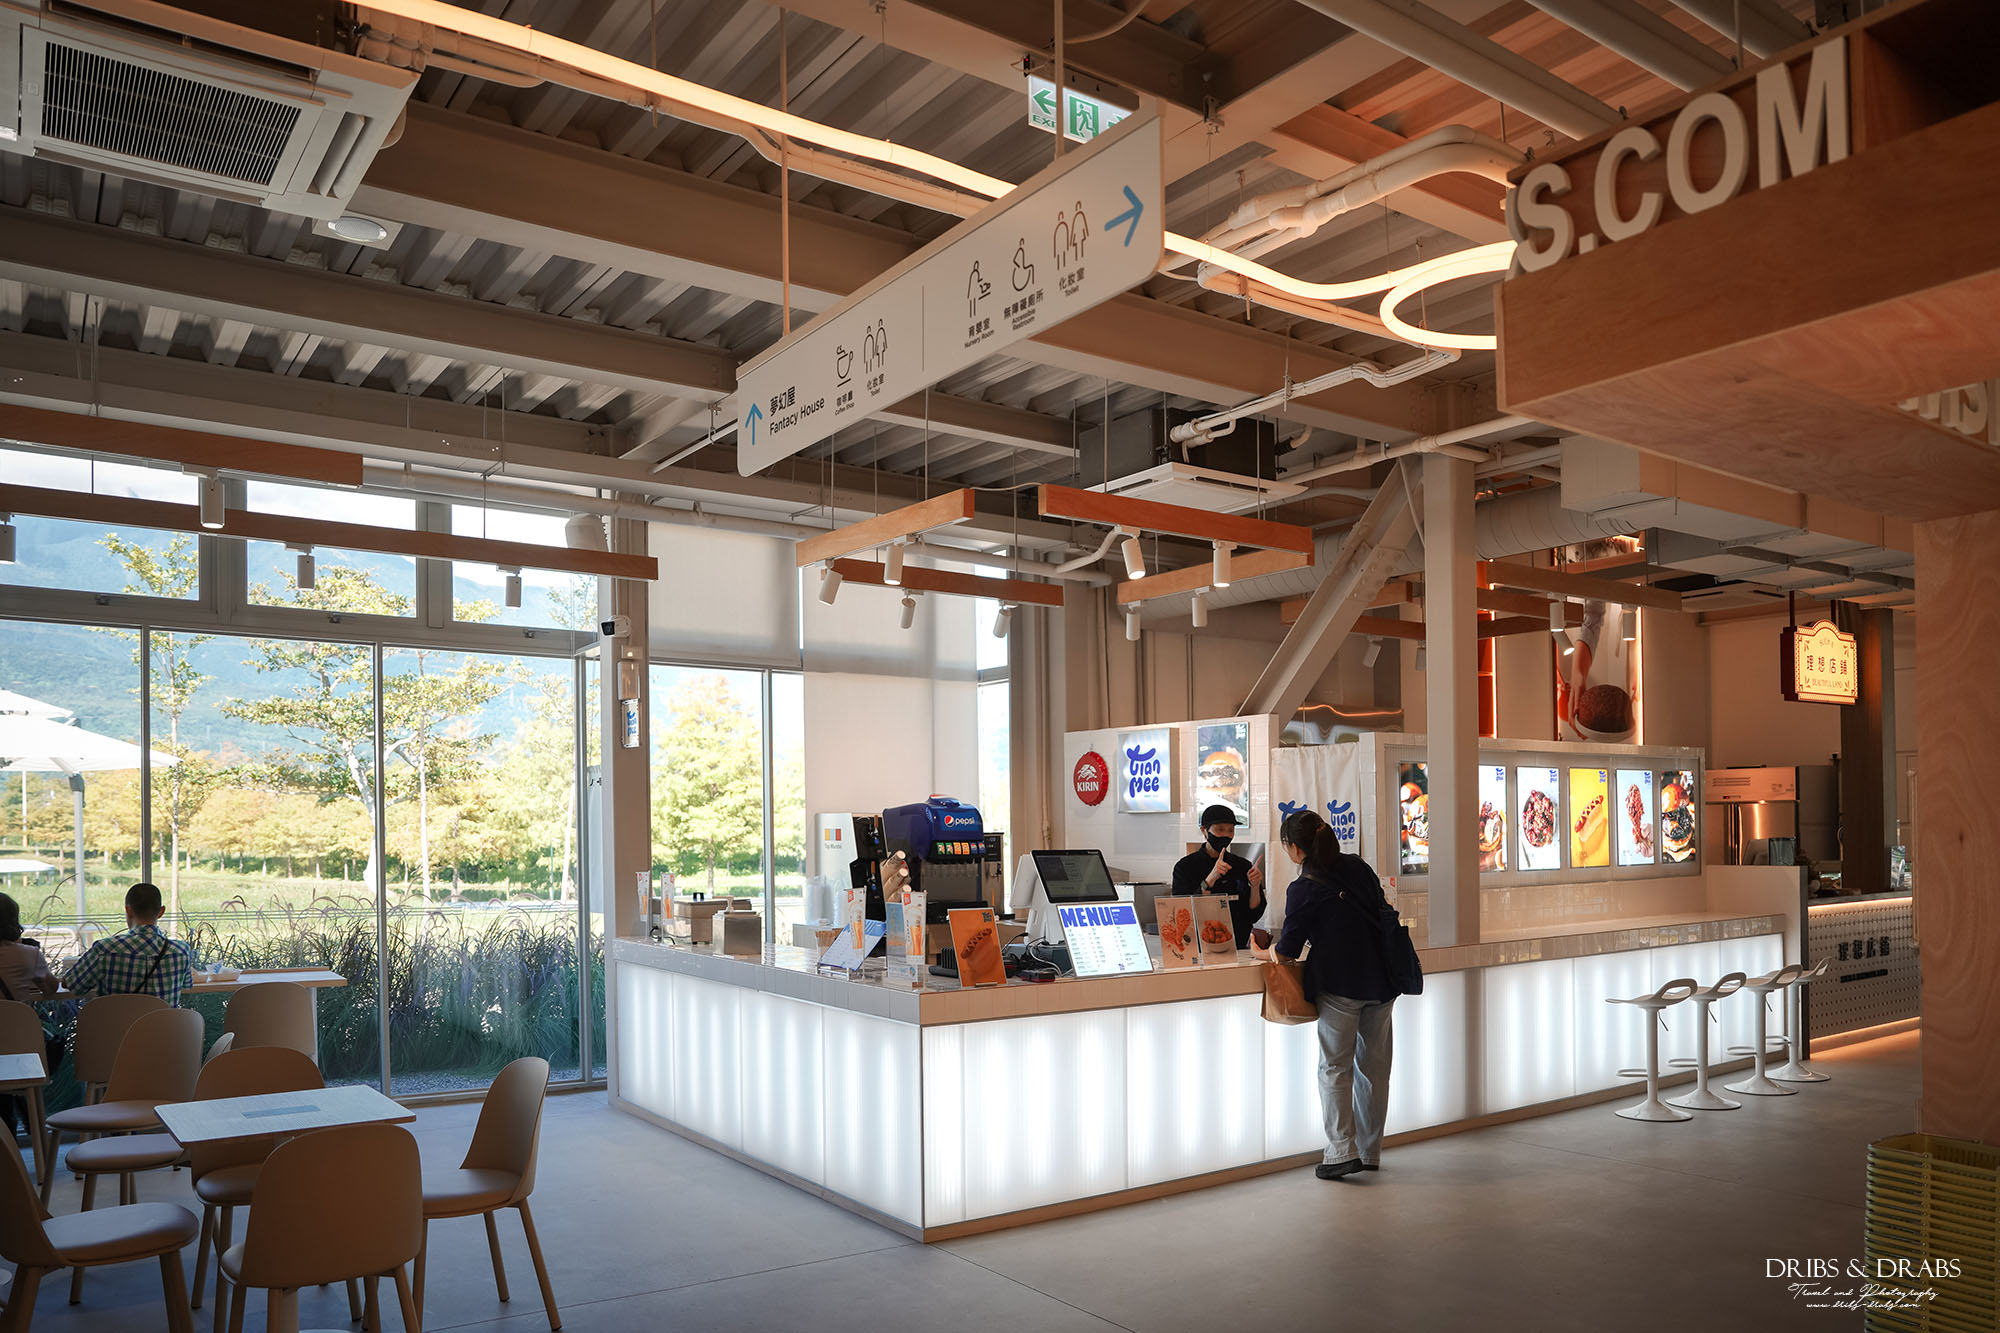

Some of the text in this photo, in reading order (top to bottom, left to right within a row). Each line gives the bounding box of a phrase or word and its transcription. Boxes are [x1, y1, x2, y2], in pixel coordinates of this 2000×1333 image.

[1032, 114, 1056, 128] EXI
[1516, 36, 1849, 273] S.COM
[1065, 285, 1079, 297] Toilet
[981, 329, 995, 341] Room
[770, 385, 796, 417] 夢幻屋
[769, 397, 825, 436] Fantacy House
[1077, 781, 1099, 792] KIRIN
[955, 816, 975, 826] pepsi
[1059, 906, 1114, 928] MENU
